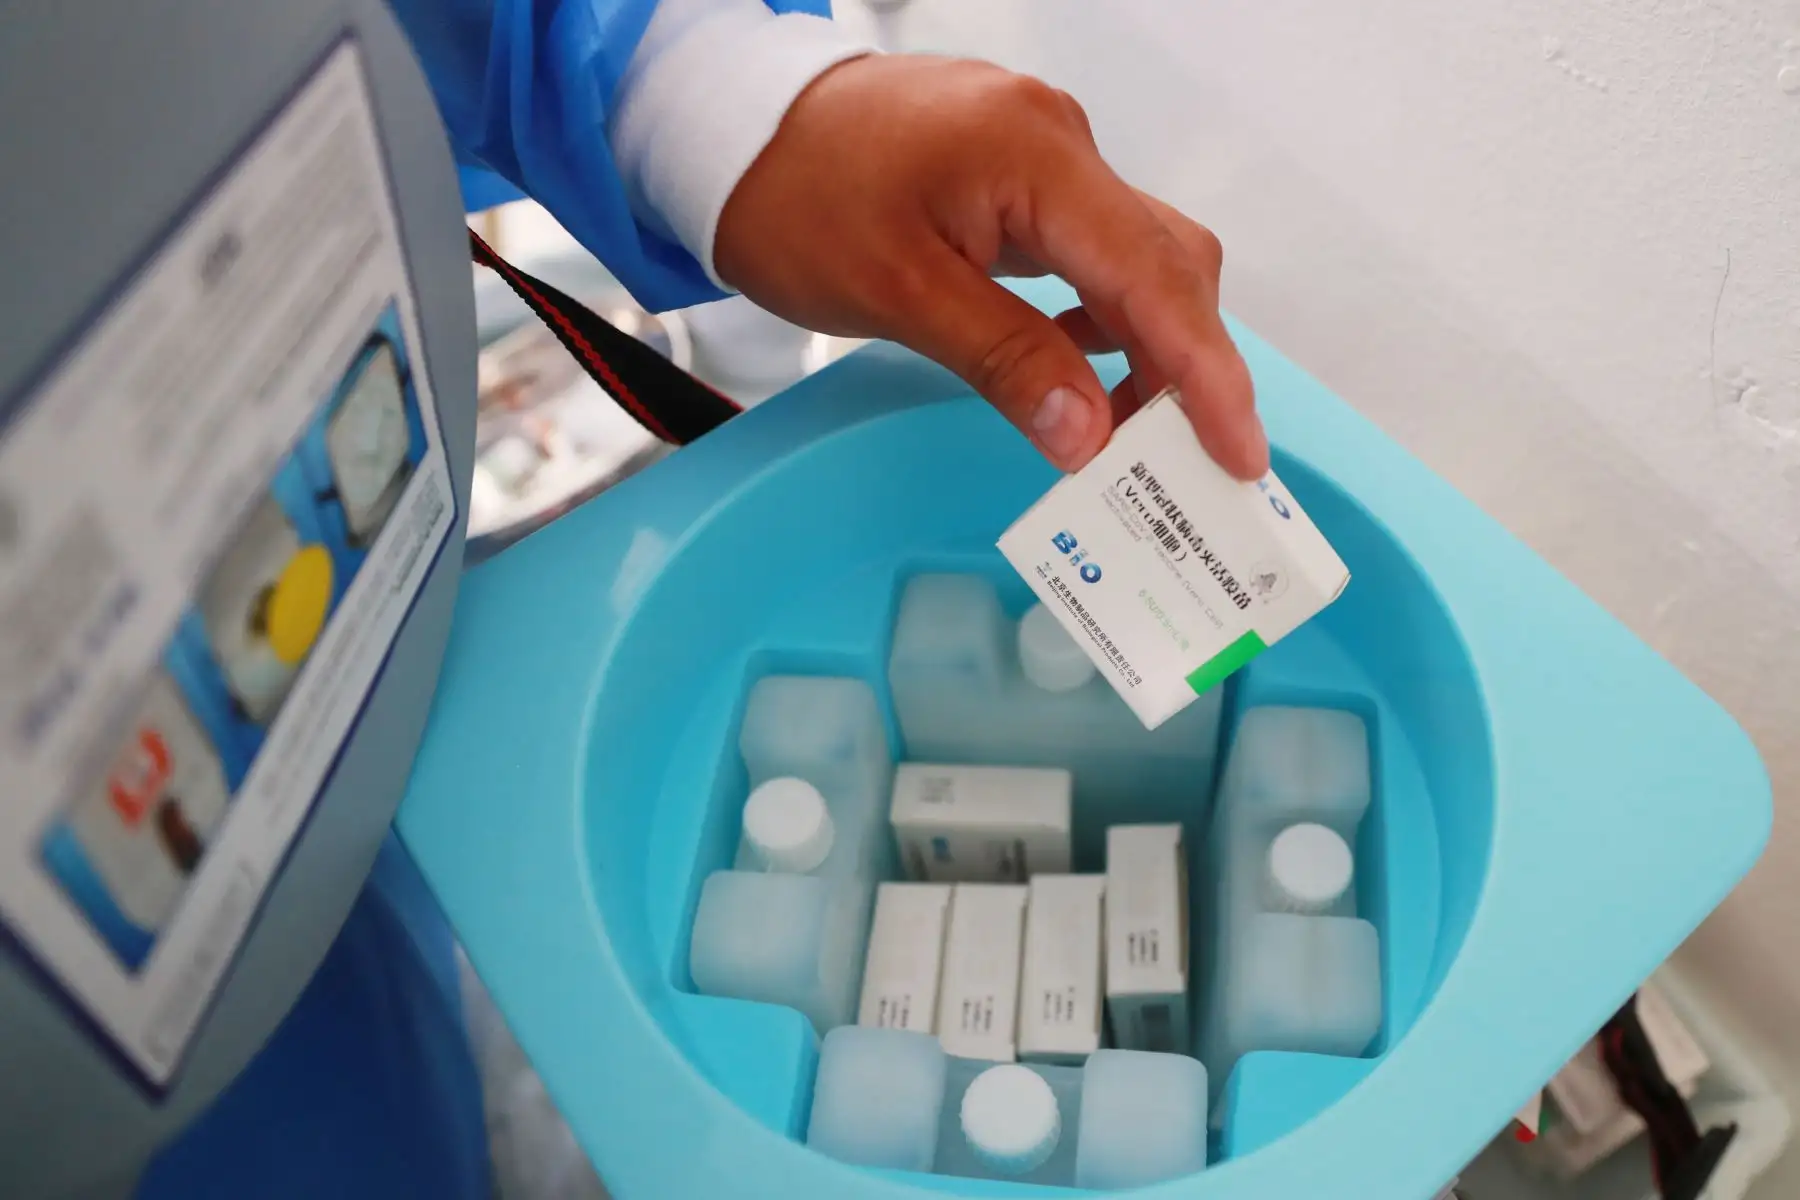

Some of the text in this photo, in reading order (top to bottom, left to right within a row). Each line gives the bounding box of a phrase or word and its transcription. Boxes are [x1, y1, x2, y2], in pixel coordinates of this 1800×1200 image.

[1046, 580, 1061, 598] Beijing
[1060, 597, 1078, 618] Institute
[1081, 623, 1102, 647] Biological
[1100, 646, 1119, 669] Products
[1051, 575, 1142, 684] 北京生物制品研究所有限责任公司
